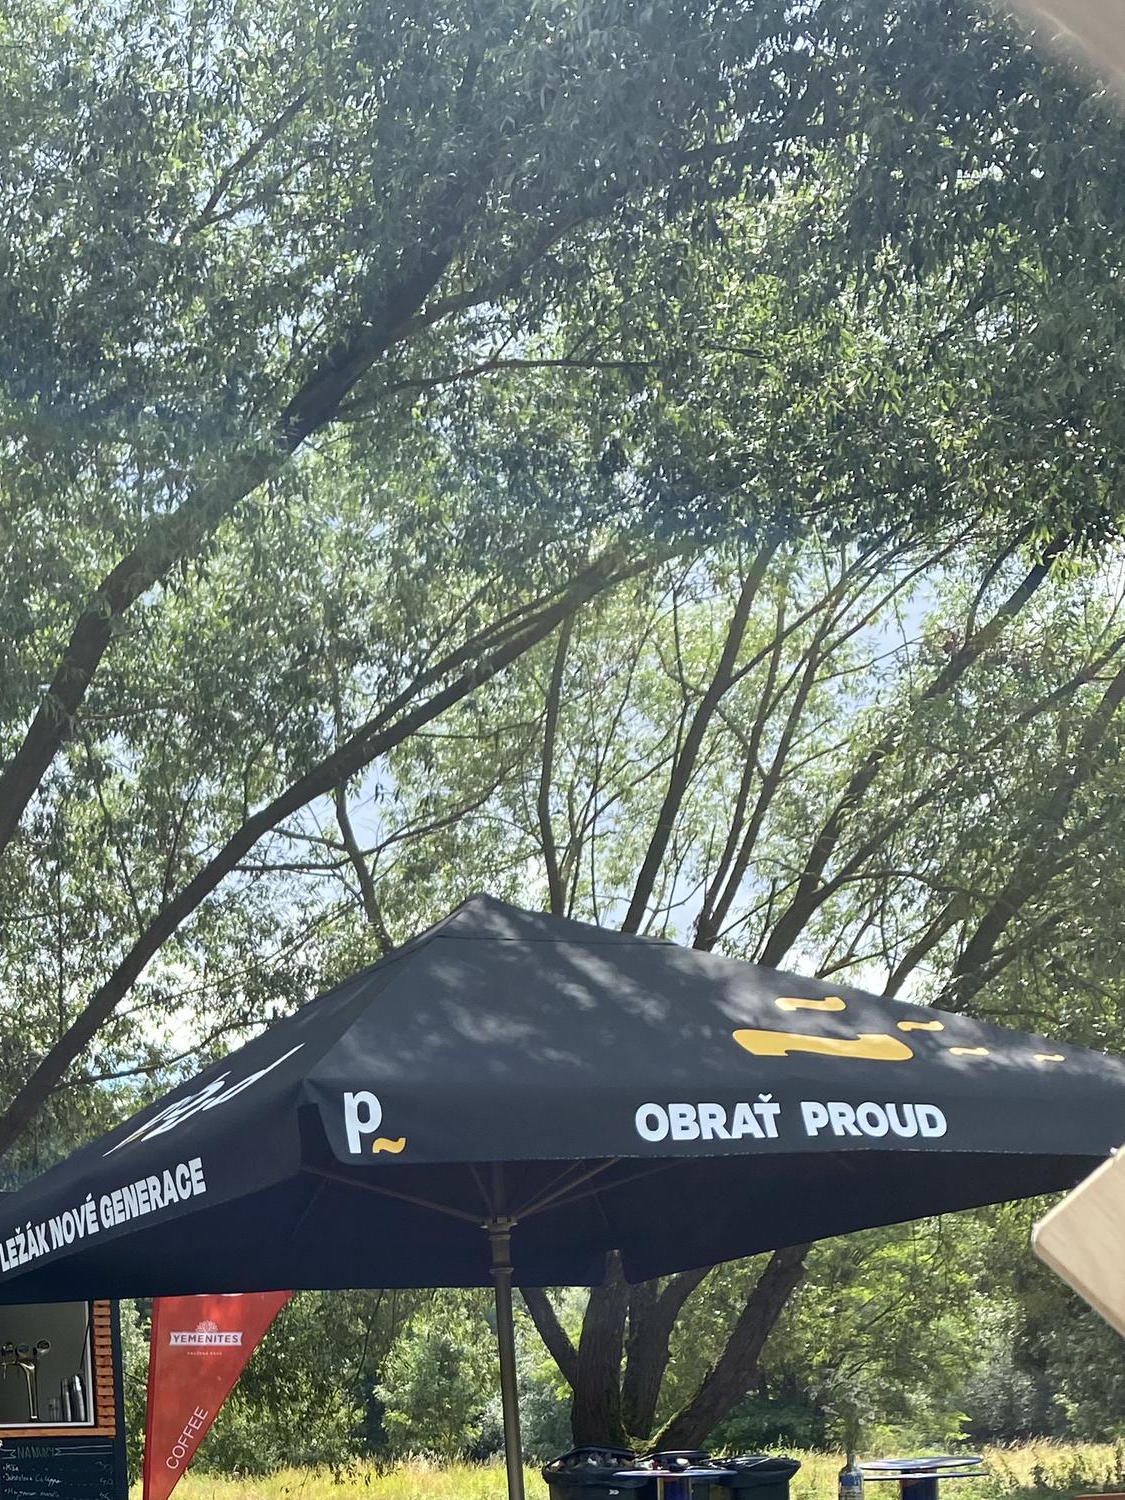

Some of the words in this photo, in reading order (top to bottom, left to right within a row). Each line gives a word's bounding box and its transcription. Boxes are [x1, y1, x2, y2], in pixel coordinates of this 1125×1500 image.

[635, 1092, 781, 1142] OBRAŤ
[799, 1101, 947, 1138] PROUD
[50, 1192, 100, 1250] NOVÉ
[100, 1157, 207, 1229] GENERACE
[173, 1334, 239, 1344] YEMENITES
[165, 1405, 209, 1470] COFFEE
